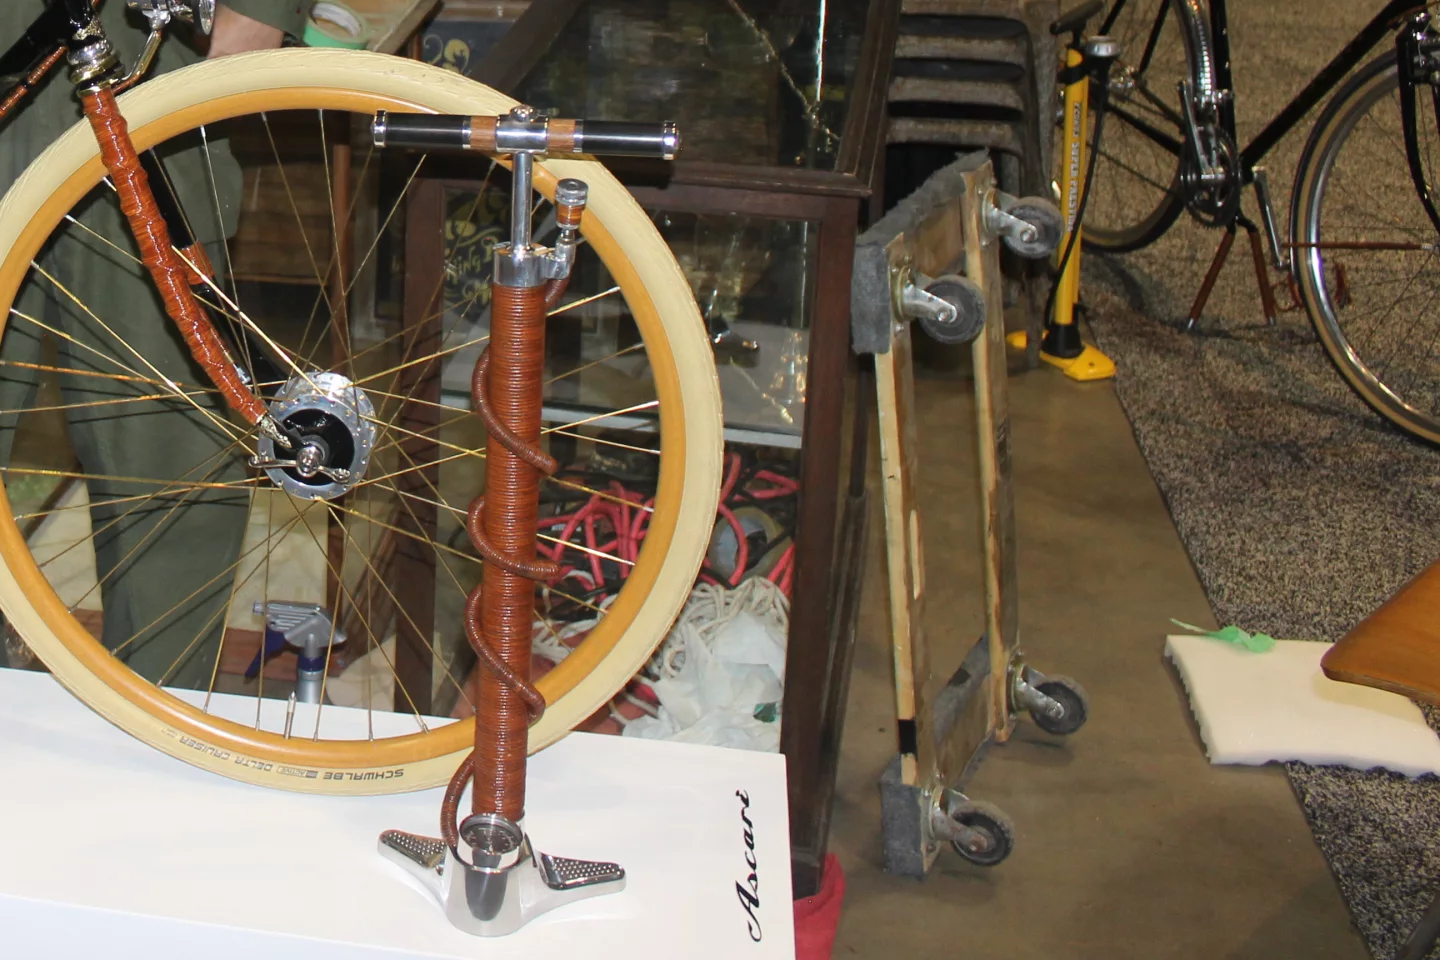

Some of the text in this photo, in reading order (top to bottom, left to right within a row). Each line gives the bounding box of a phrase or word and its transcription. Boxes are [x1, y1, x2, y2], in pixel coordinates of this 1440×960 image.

[179, 737, 231, 764] CRUISER
[234, 756, 273, 772] DELTA
[323, 768, 405, 781] SCHWALBE
[735, 789, 763, 943] Ascari
